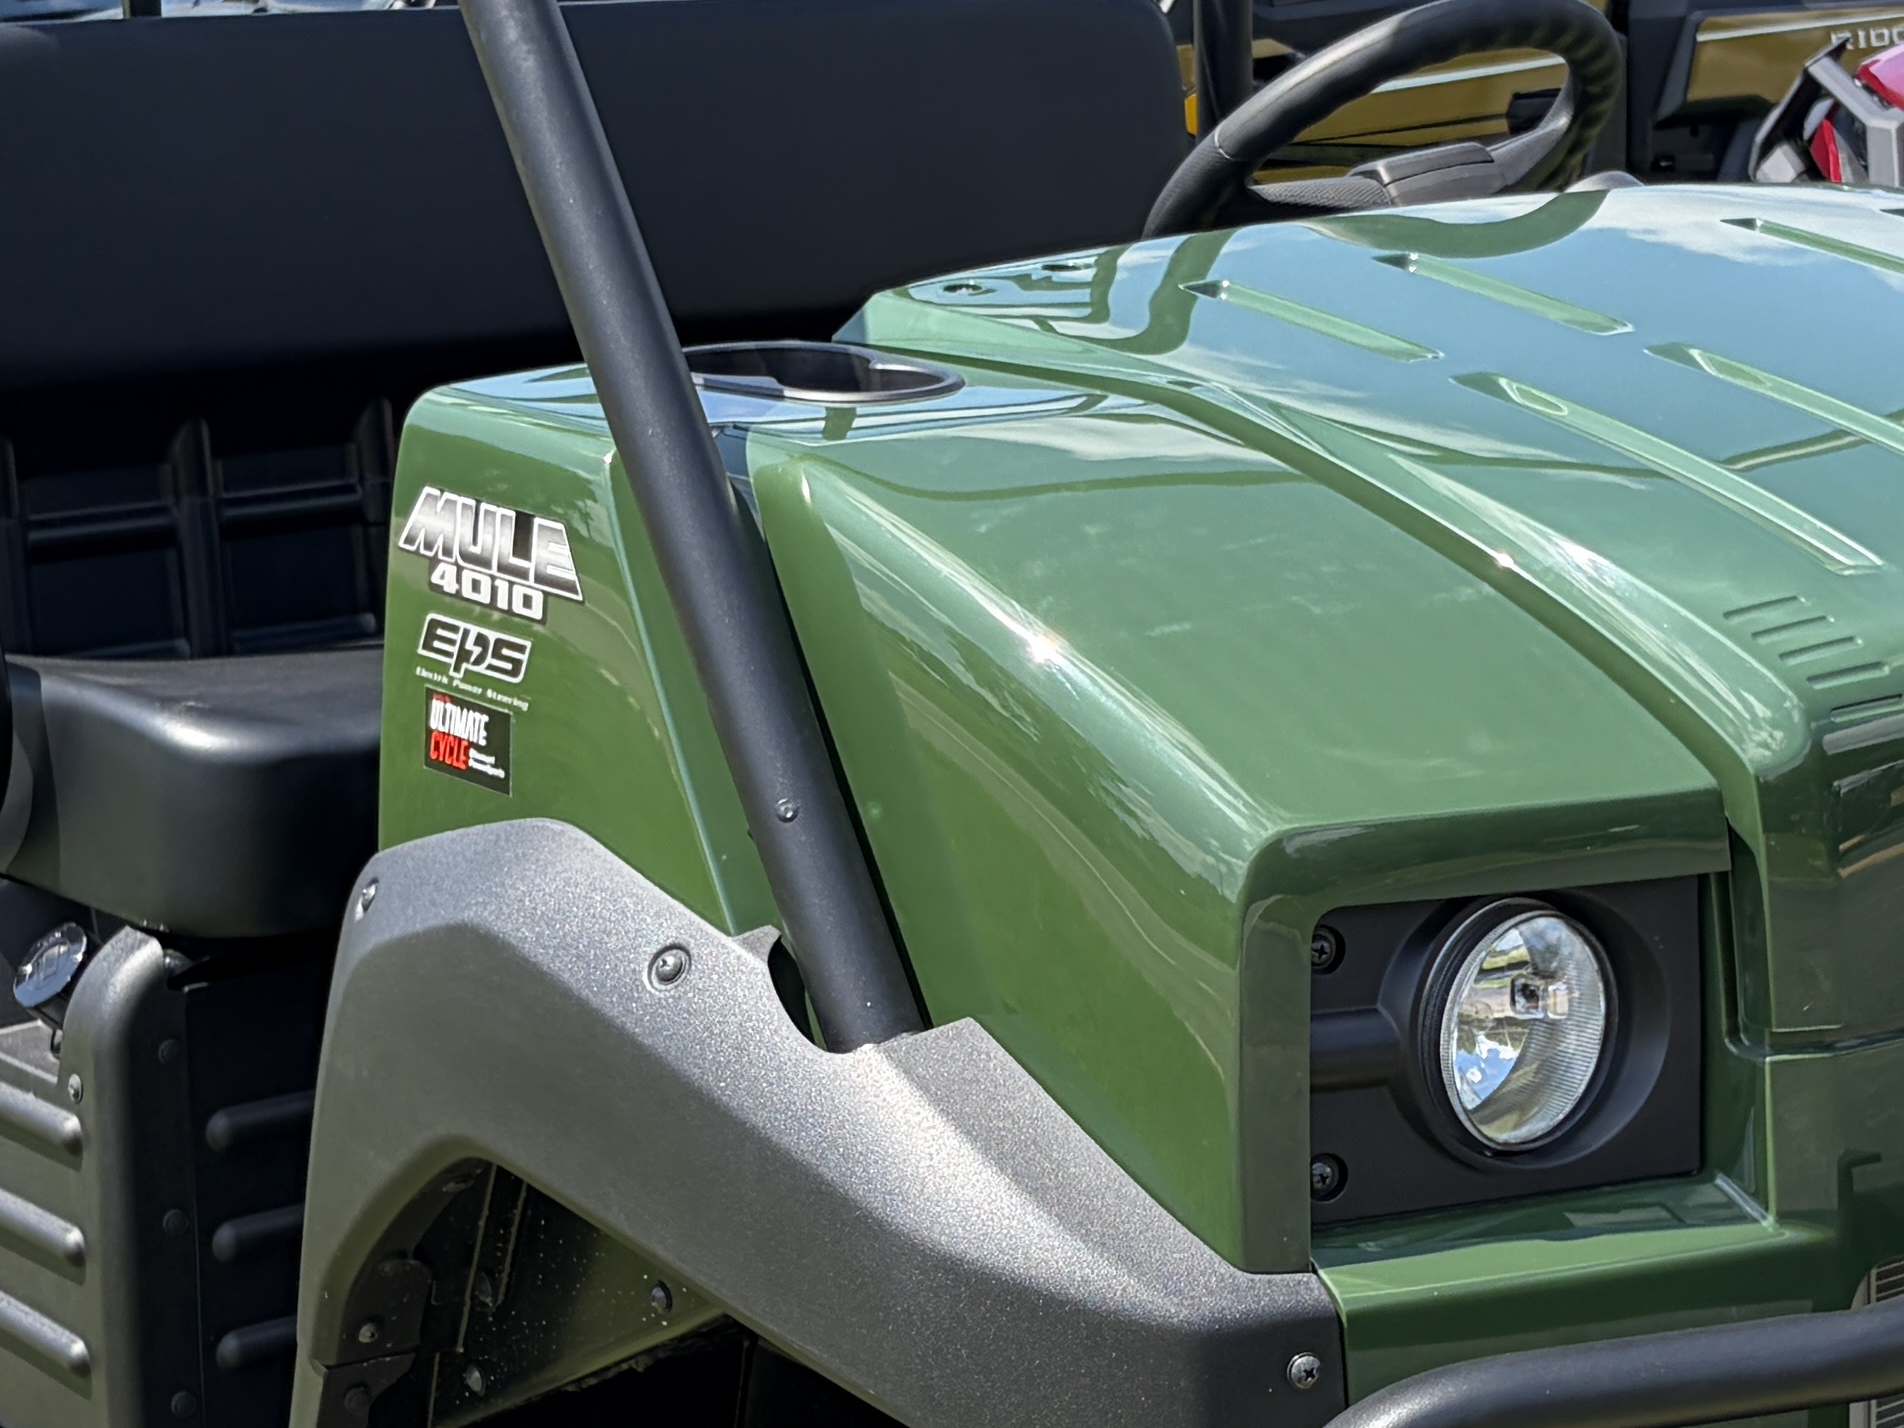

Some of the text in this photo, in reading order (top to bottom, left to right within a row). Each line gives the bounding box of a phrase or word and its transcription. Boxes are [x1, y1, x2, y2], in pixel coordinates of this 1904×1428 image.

[399, 485, 583, 602] MULE
[430, 564, 543, 620] 4010
[430, 698, 489, 746] ULTIMATE
[430, 731, 469, 770] CYCLE
